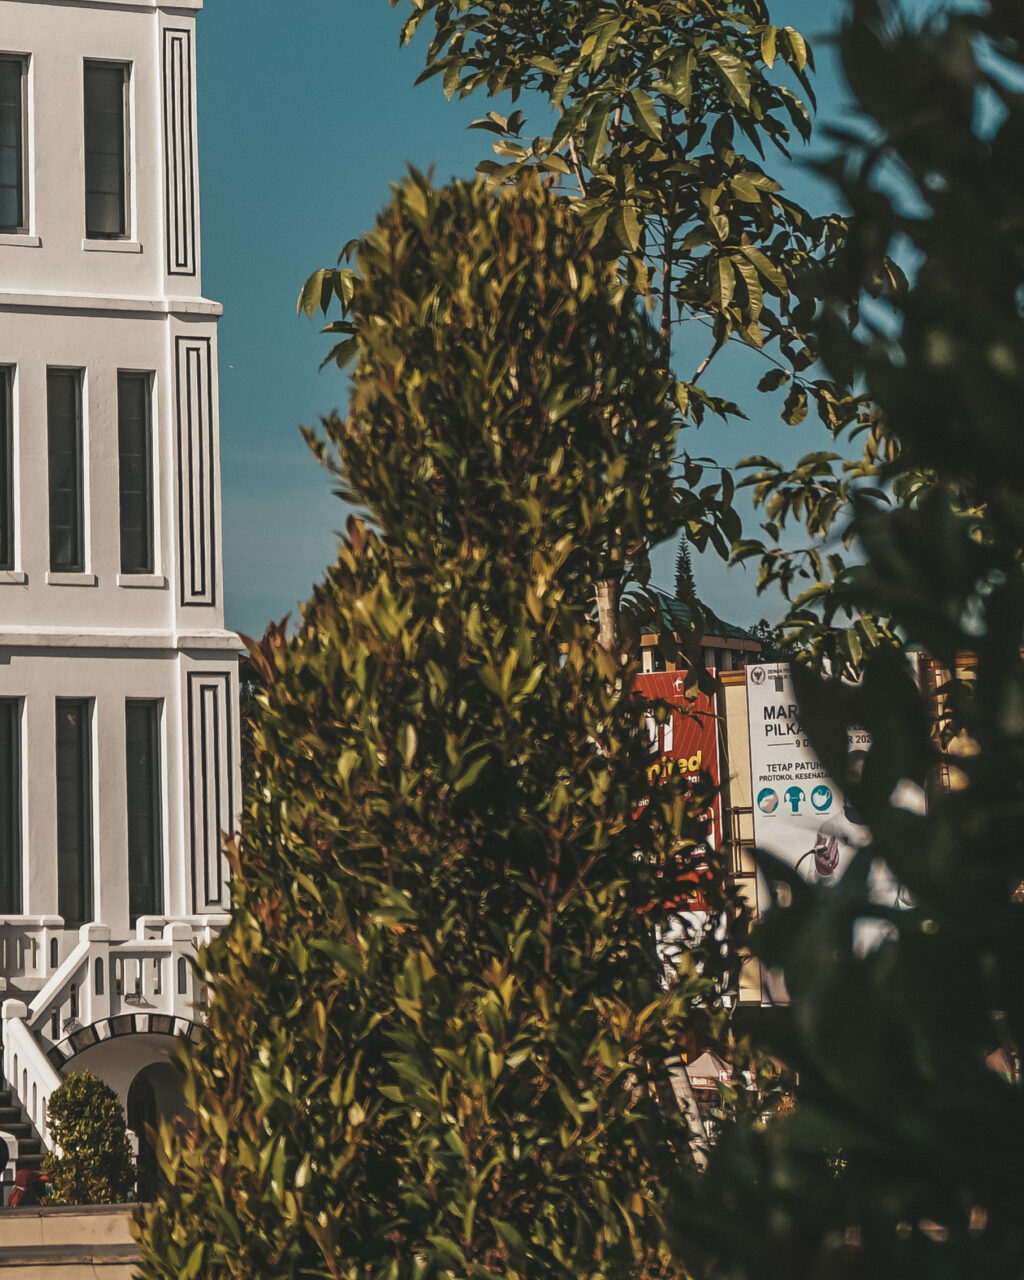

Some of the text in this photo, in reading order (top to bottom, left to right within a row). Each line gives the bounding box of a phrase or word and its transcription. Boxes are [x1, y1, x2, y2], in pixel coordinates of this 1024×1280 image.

[764, 704, 798, 720] MAR
[765, 723, 806, 736] PILKA
[855, 734, 871, 744] 202
[766, 761, 824, 772] TETAP PATUH
[759, 773, 794, 782] PROTOKOL
